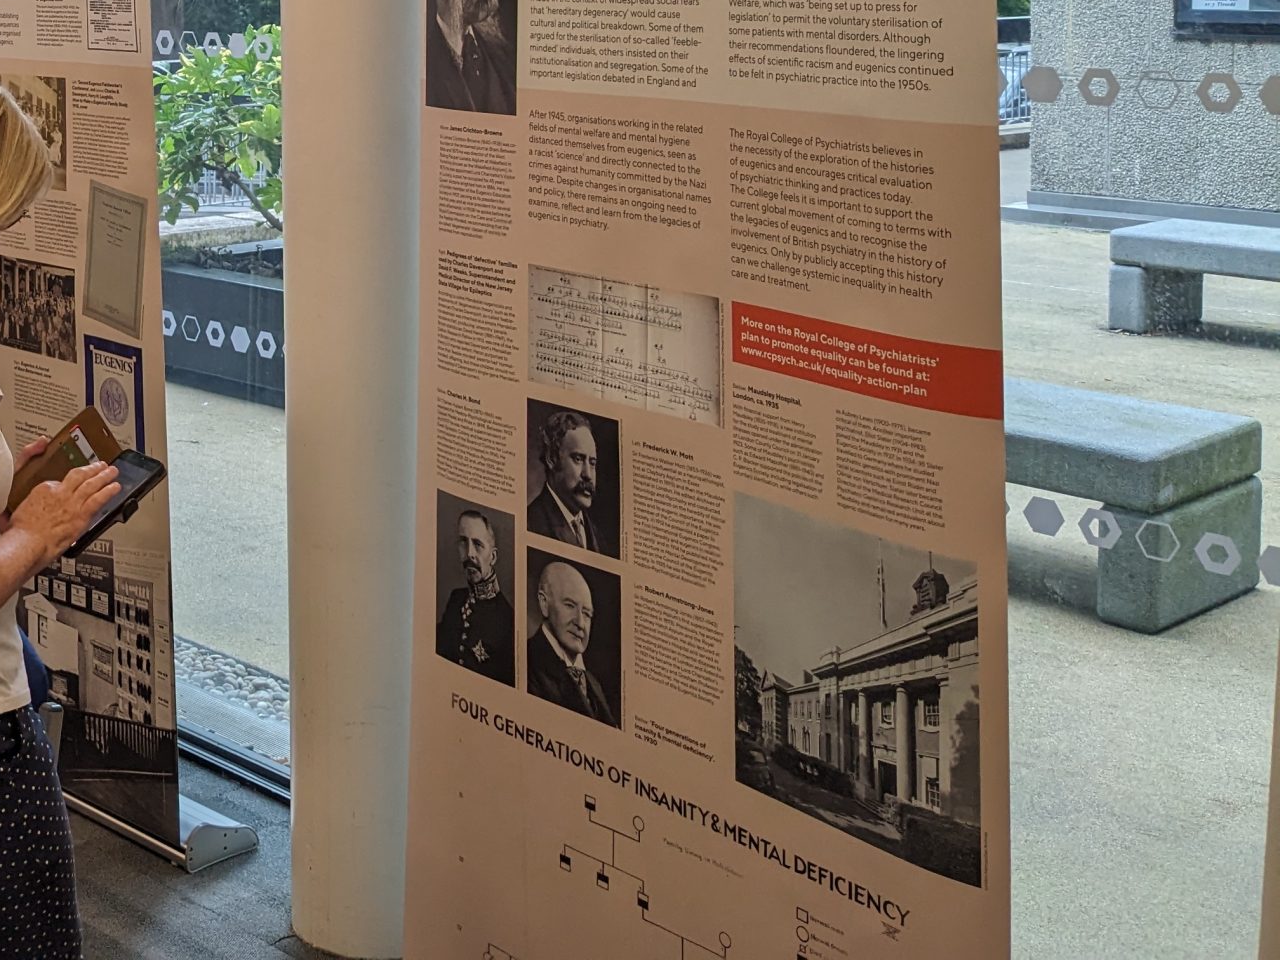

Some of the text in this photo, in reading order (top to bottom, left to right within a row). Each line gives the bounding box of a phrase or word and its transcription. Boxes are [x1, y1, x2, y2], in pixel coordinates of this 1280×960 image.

[728, 53, 954, 76] effects of scientific racism and eugenics continued
[529, 110, 703, 134] After 1945, organisations working in the related
[729, 128, 923, 158] The Royal College of Psychiatrists believes in
[741, 316, 939, 367] More on the Royal College of Psychiatrists'
[94, 352, 133, 374] EUGENICS
[741, 331, 930, 381] plan to promote equality can be found at:
[741, 345, 927, 397] www.rcpsych.ac.uk/equality-action-plan
[747, 385, 802, 407] Maudsley Hospital,
[643, 442, 694, 461] Frederick W. Mott
[451, 692, 489, 726] FOUR
[494, 714, 604, 777] GENERATIONS
[608, 766, 631, 788] OF
[635, 776, 712, 827] INSANITY
[711, 814, 722, 834] &
[724, 820, 791, 870] MENTAL
[794, 855, 911, 926] DEFICIENCY
